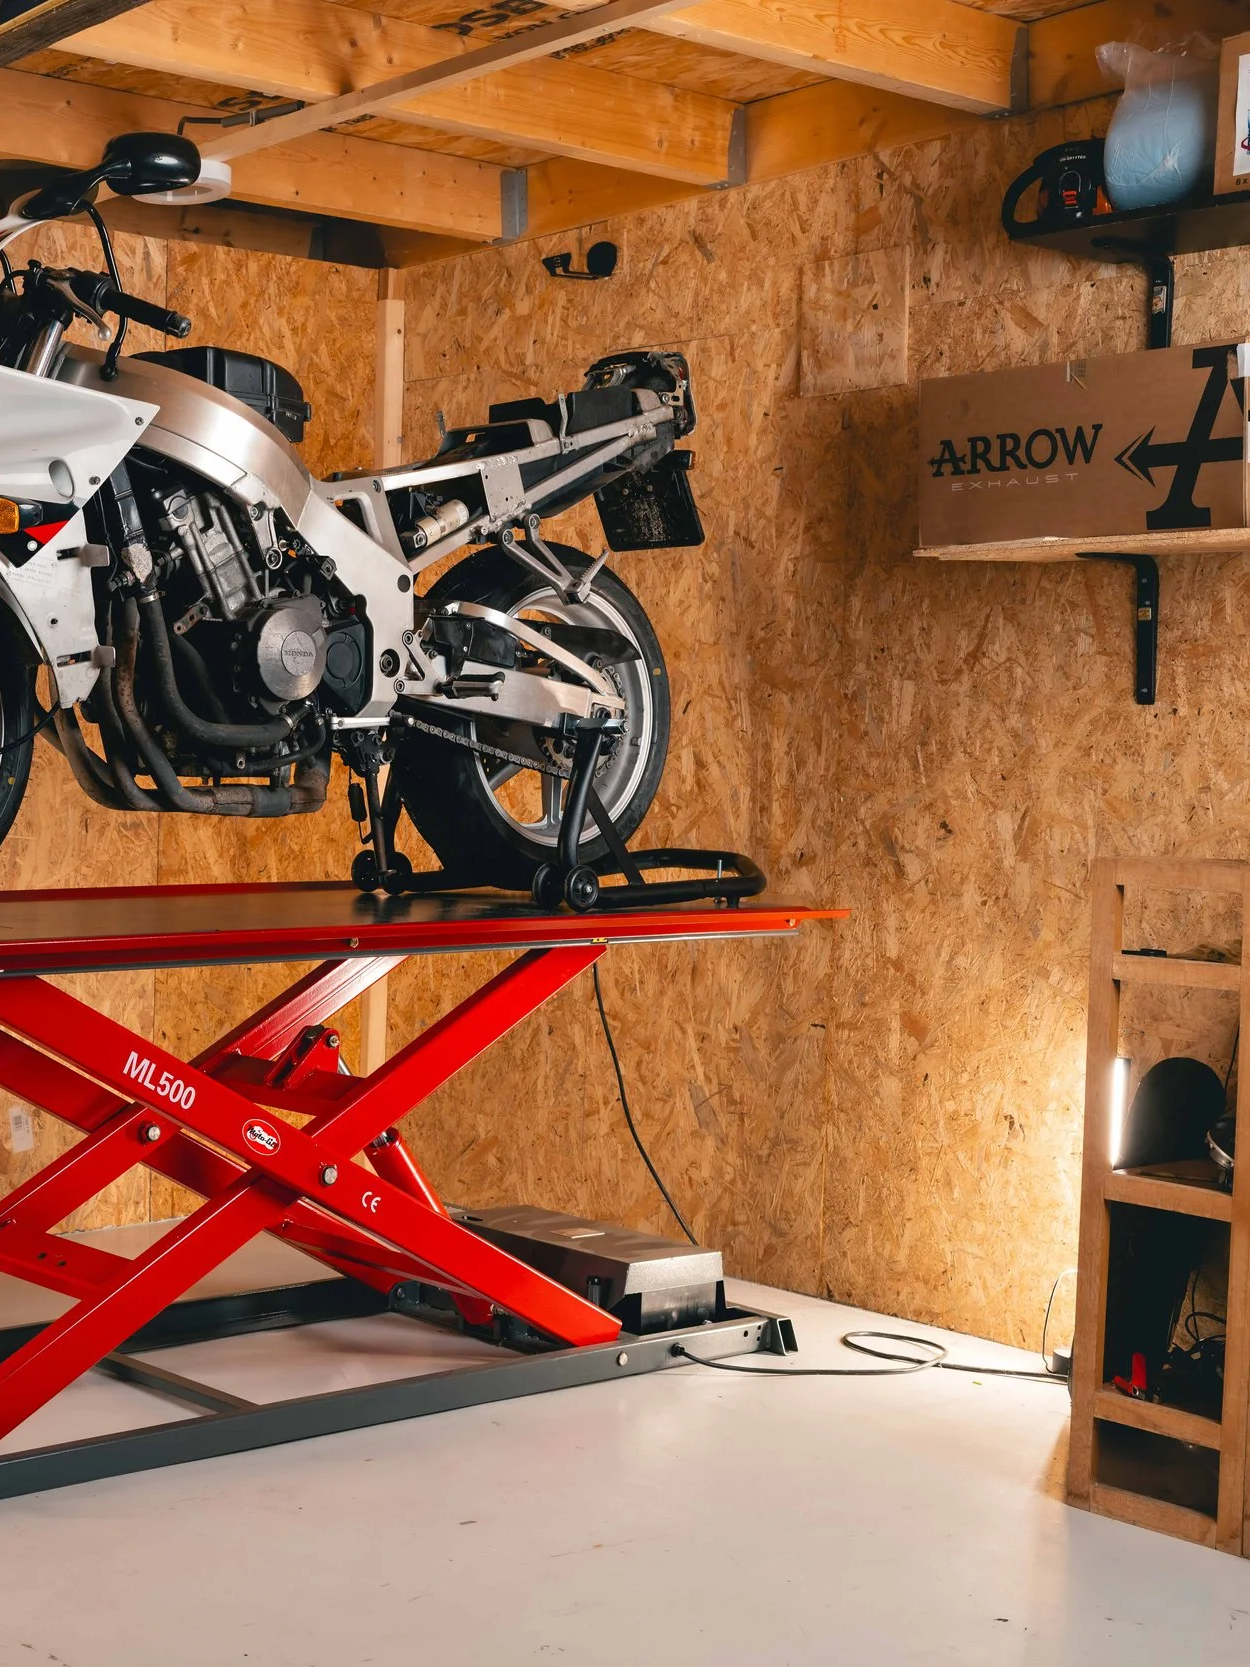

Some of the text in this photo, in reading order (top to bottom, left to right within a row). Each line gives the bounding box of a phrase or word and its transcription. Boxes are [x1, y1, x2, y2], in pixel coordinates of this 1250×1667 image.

[927, 423, 1103, 477] ARROW
[951, 472, 1079, 492] EXHAUST
[123, 1050, 196, 1110] ML500
